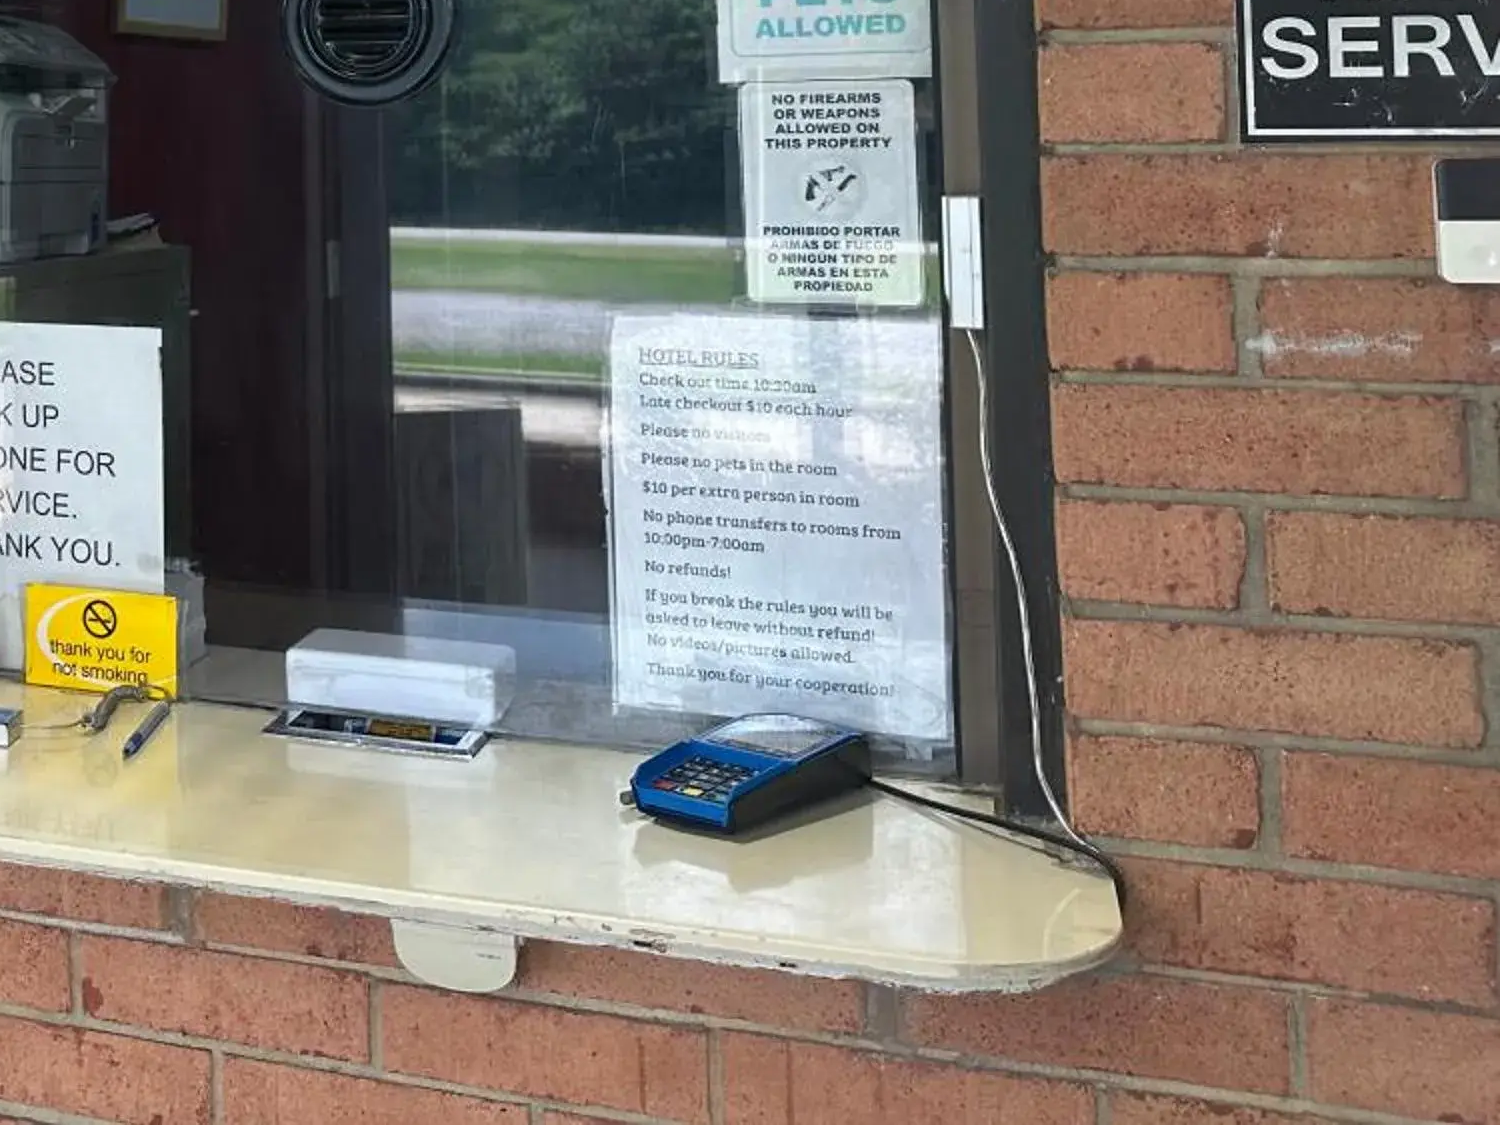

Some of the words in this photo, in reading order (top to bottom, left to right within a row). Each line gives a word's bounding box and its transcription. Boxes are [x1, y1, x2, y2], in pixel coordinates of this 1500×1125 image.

[755, 13, 907, 39] ALLOWED
[771, 93, 795, 106] NO
[799, 92, 882, 105] FIREARMS
[773, 108, 797, 120] OR
[801, 107, 881, 120] WEAPONS
[775, 122, 851, 135] ALLOWED
[856, 122, 880, 134] ON
[764, 138, 802, 149] THIS
[807, 136, 893, 150] PROPERTY
[763, 226, 840, 237] PROHIBIDO
[843, 226, 901, 237] PORTAR
[771, 240, 819, 250] ARMAS
[823, 240, 841, 250] DE
[767, 253, 778, 264] O
[841, 254, 875, 265] TIPO
[879, 254, 898, 265] DE
[777, 266, 826, 278] ARMAS
[830, 267, 849, 278] EN
[853, 268, 889, 279] ESTA
[794, 280, 873, 292] PROPIEDAD
[638, 346, 697, 366] HOTEL
[701, 350, 759, 369] RULES
[639, 372, 685, 388] Check
[715, 376, 749, 390] time
[22, 404, 60, 429] UP
[640, 394, 671, 409] Late
[675, 396, 742, 412] checkout
[746, 400, 773, 414] $10
[775, 402, 813, 416] each
[815, 403, 853, 418] hour
[641, 422, 689, 438] Please
[57, 449, 117, 477] FOR
[641, 452, 689, 467] Please
[692, 458, 711, 468] no
[714, 458, 746, 472] pets
[749, 458, 765, 472] in
[768, 459, 794, 474] the
[797, 462, 838, 476] room
[642, 480, 667, 494] $10
[671, 484, 696, 498] per
[699, 486, 740, 500] extra
[743, 489, 797, 504] person
[799, 491, 815, 505] in
[818, 493, 860, 508] room
[643, 508, 663, 522] No
[667, 510, 713, 527] phone
[716, 515, 788, 532] transfers
[791, 520, 807, 533] to
[809, 522, 859, 538] rooms
[862, 524, 902, 540] from
[51, 537, 121, 568] YOU.
[644, 559, 665, 574] No
[667, 561, 732, 579] refunds!
[645, 588, 657, 602] If
[660, 591, 688, 606] you
[690, 591, 735, 608] break
[738, 596, 763, 611] the
[766, 600, 805, 614] rules
[809, 604, 838, 618] you
[841, 605, 871, 620] will
[873, 606, 893, 622] be
[645, 612, 689, 627] asked
[692, 615, 708, 628] to
[711, 616, 750, 633] leave
[753, 620, 815, 638] without
[817, 626, 875, 642] refund!
[49, 639, 93, 658] thank
[95, 646, 126, 665] you
[129, 645, 152, 664] for
[647, 633, 667, 647] No
[669, 634, 787, 658] videos/pictures
[52, 660, 78, 676] not
[80, 663, 148, 684] smoking
[646, 662, 697, 678] Thank
[697, 669, 726, 683] you
[728, 668, 753, 684] for
[756, 675, 792, 690] your
[795, 678, 896, 697] cooperation!
